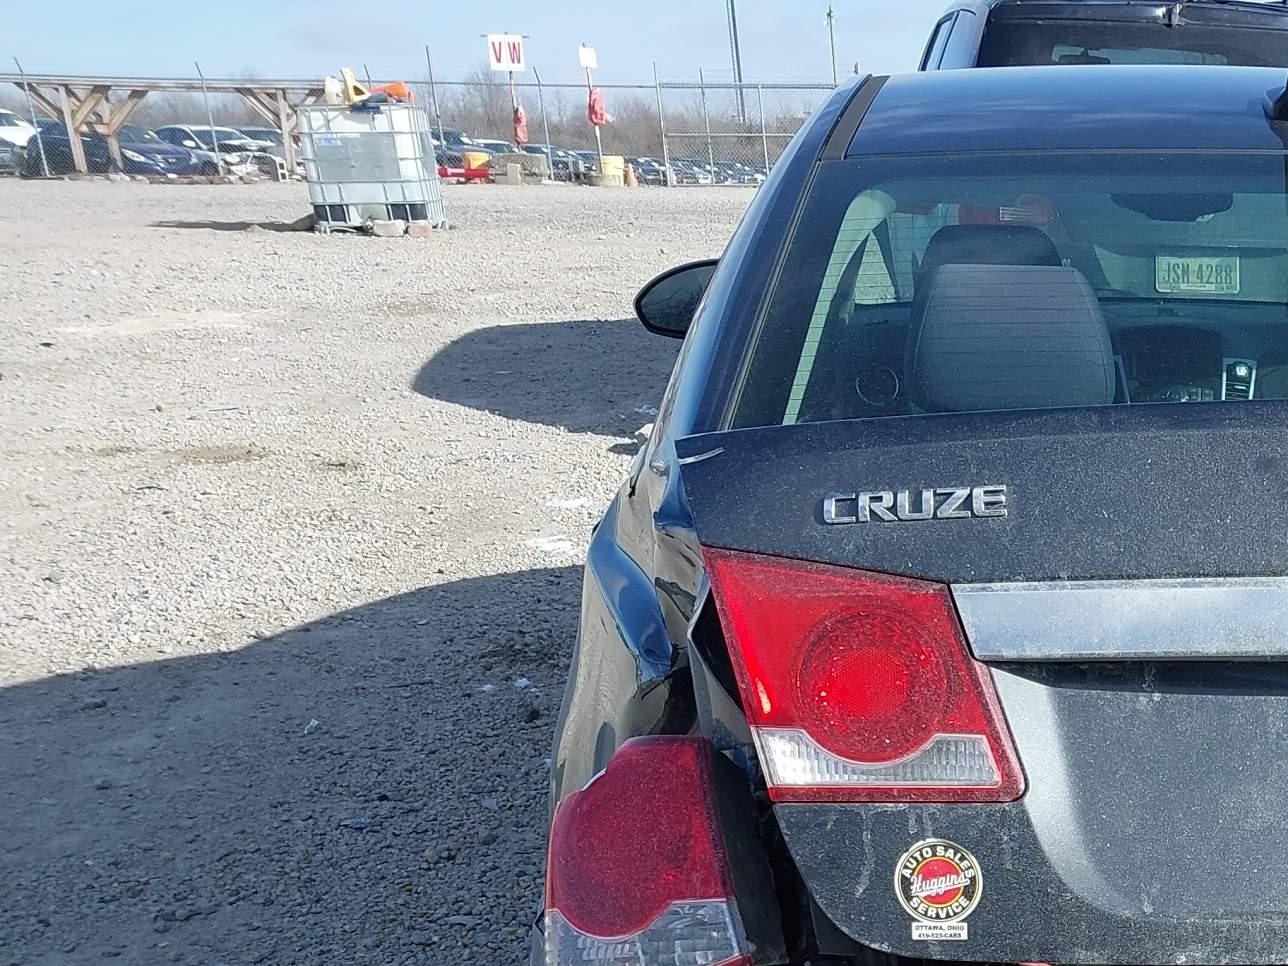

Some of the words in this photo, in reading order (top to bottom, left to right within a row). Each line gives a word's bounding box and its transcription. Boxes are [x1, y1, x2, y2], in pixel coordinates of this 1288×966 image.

[1196, 263, 1233, 285] 4288
[823, 485, 1008, 524] CRUZE
[902, 847, 933, 878] AUTO
[936, 846, 975, 878] SALES
[910, 873, 971, 896] Huggins
[910, 896, 970, 918] SERVICE
